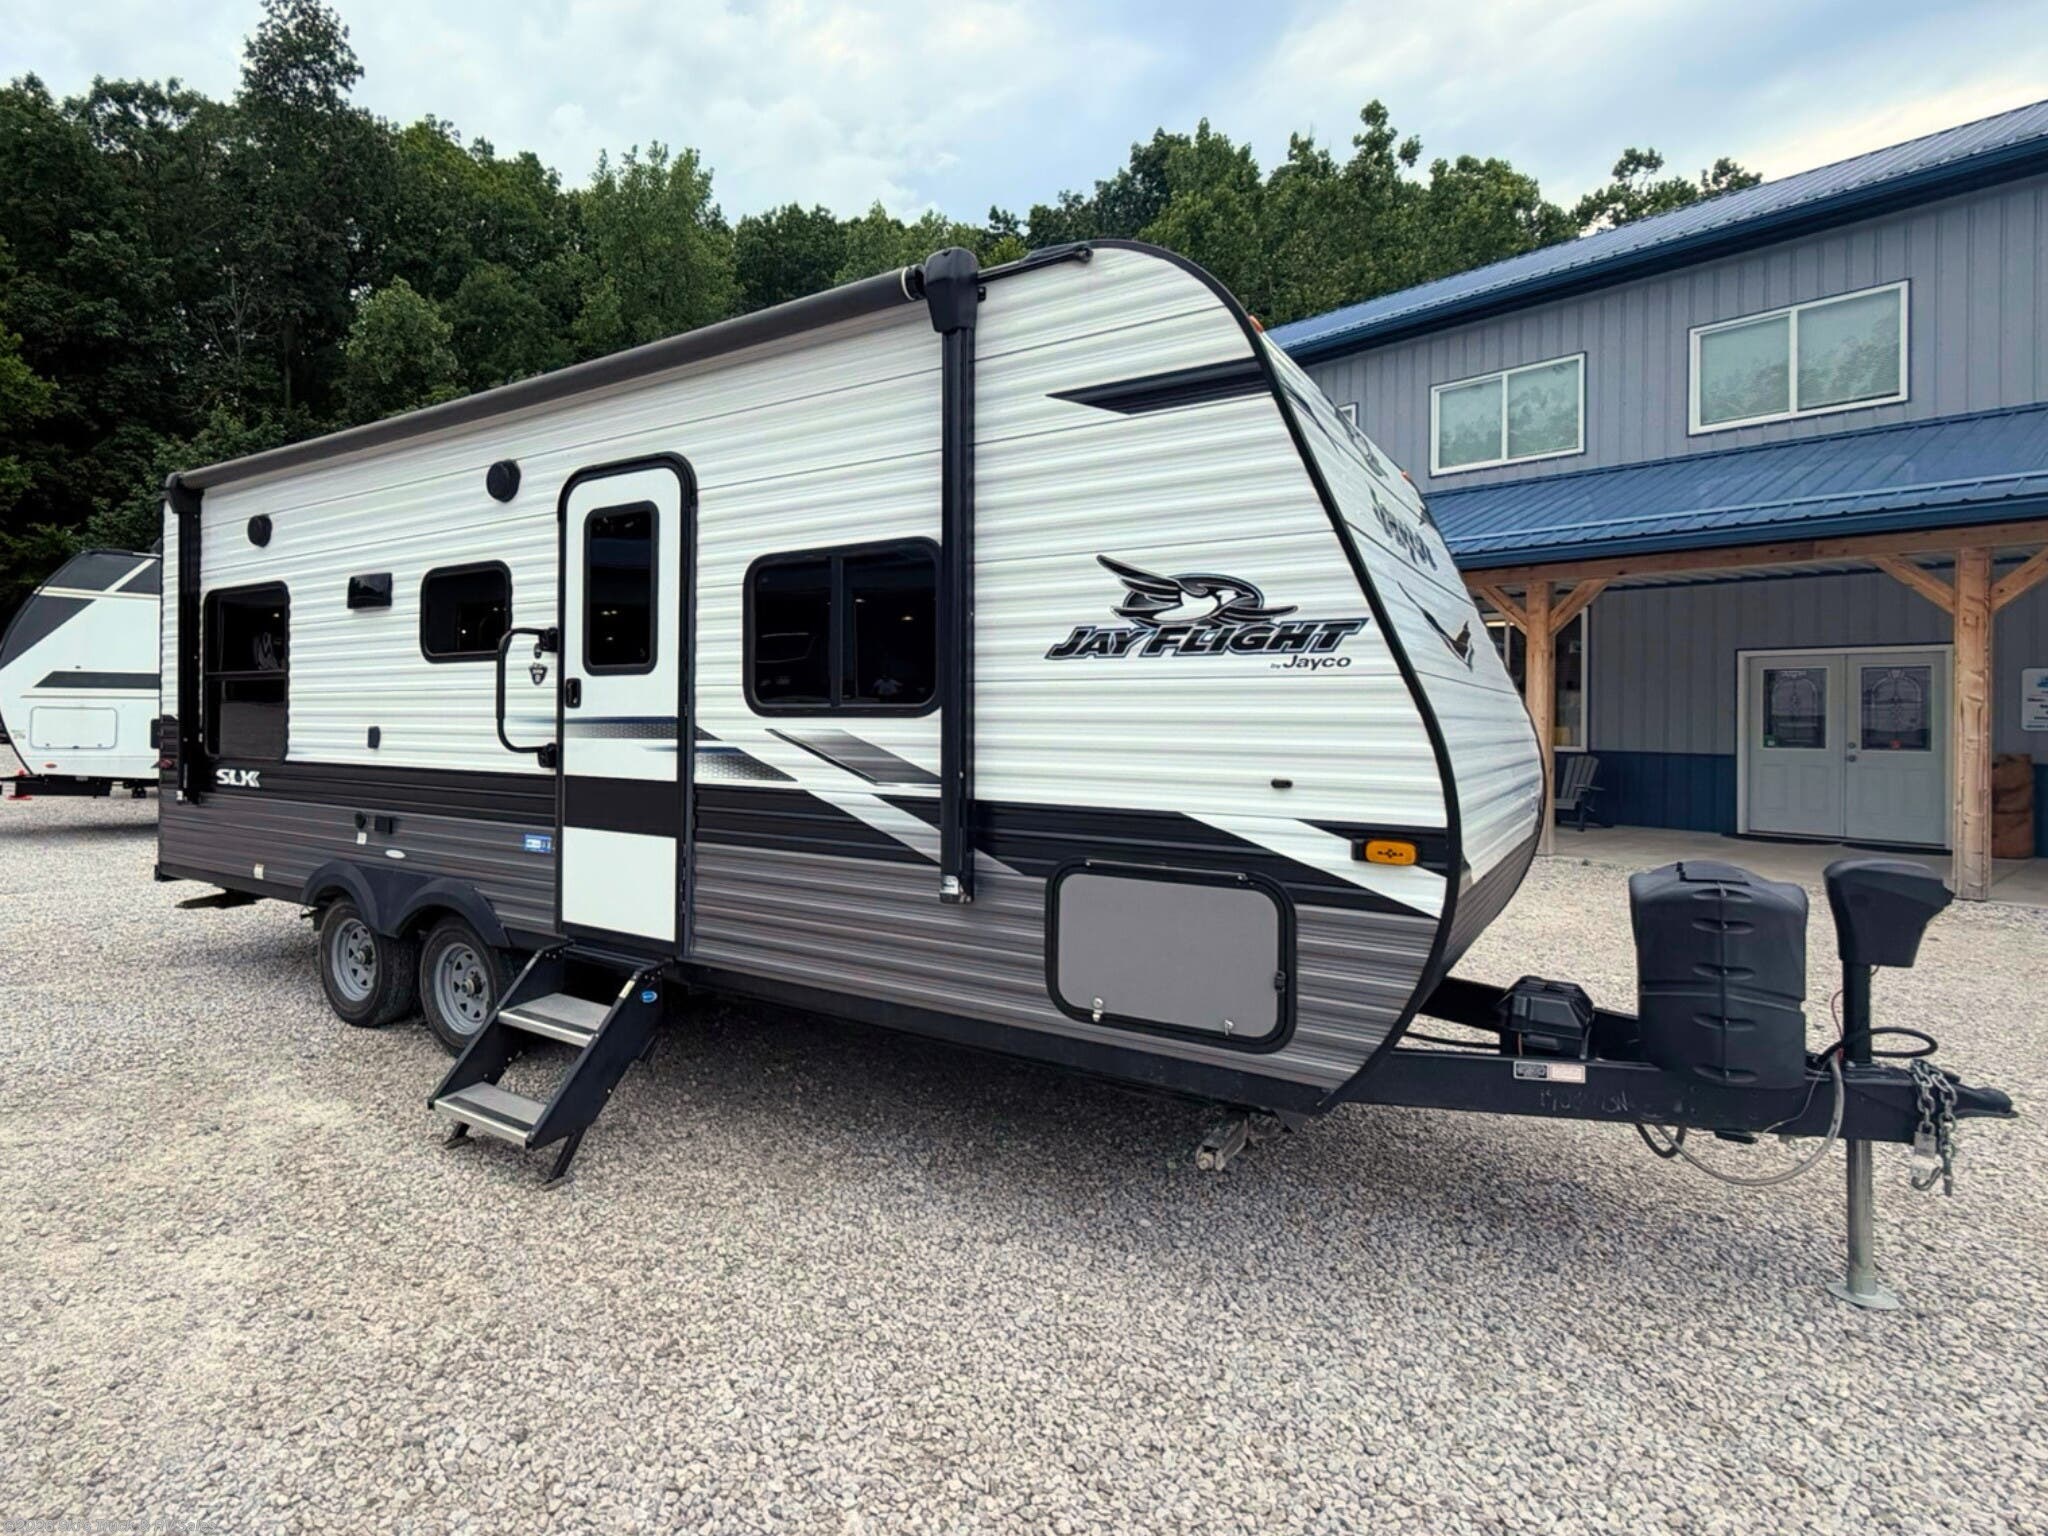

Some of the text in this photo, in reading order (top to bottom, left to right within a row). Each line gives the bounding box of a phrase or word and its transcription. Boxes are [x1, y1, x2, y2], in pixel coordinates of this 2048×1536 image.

[1044, 617, 1370, 660] JAY FLIGHT
[1283, 654, 1352, 671] Jayco
[216, 768, 260, 788] SLK
